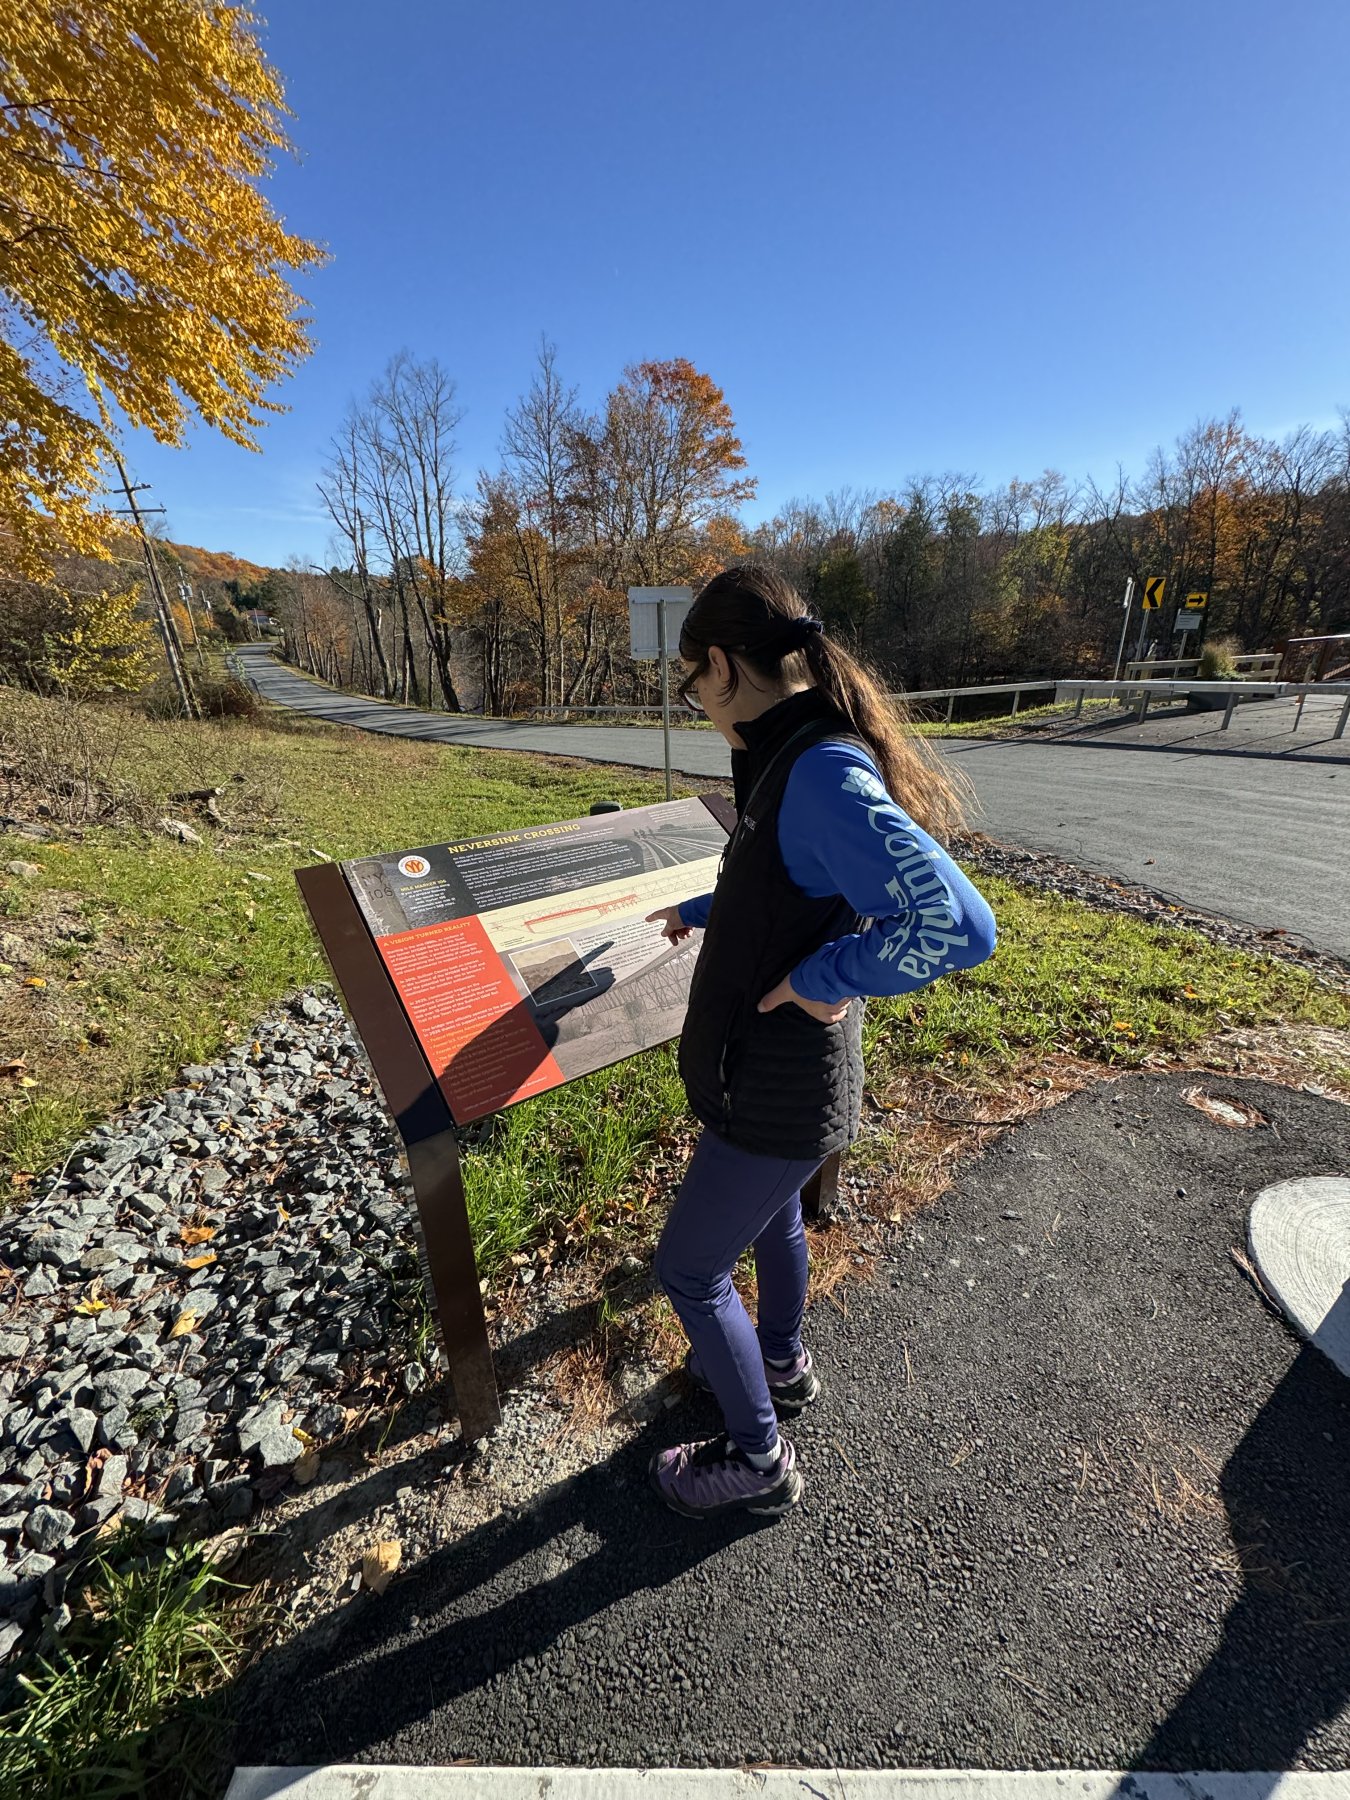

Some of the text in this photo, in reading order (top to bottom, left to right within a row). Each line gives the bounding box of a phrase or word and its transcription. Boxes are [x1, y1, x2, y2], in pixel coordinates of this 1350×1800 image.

[448, 834, 521, 854] NEVERSINK
[523, 824, 581, 840] CROSSING
[361, 872, 384, 887] NY
[368, 886, 393, 900] 106
[867, 803, 969, 979] Columbia
[390, 935, 414, 944] VISION
[415, 929, 442, 938] TURNED
[444, 922, 471, 932] REALITY
